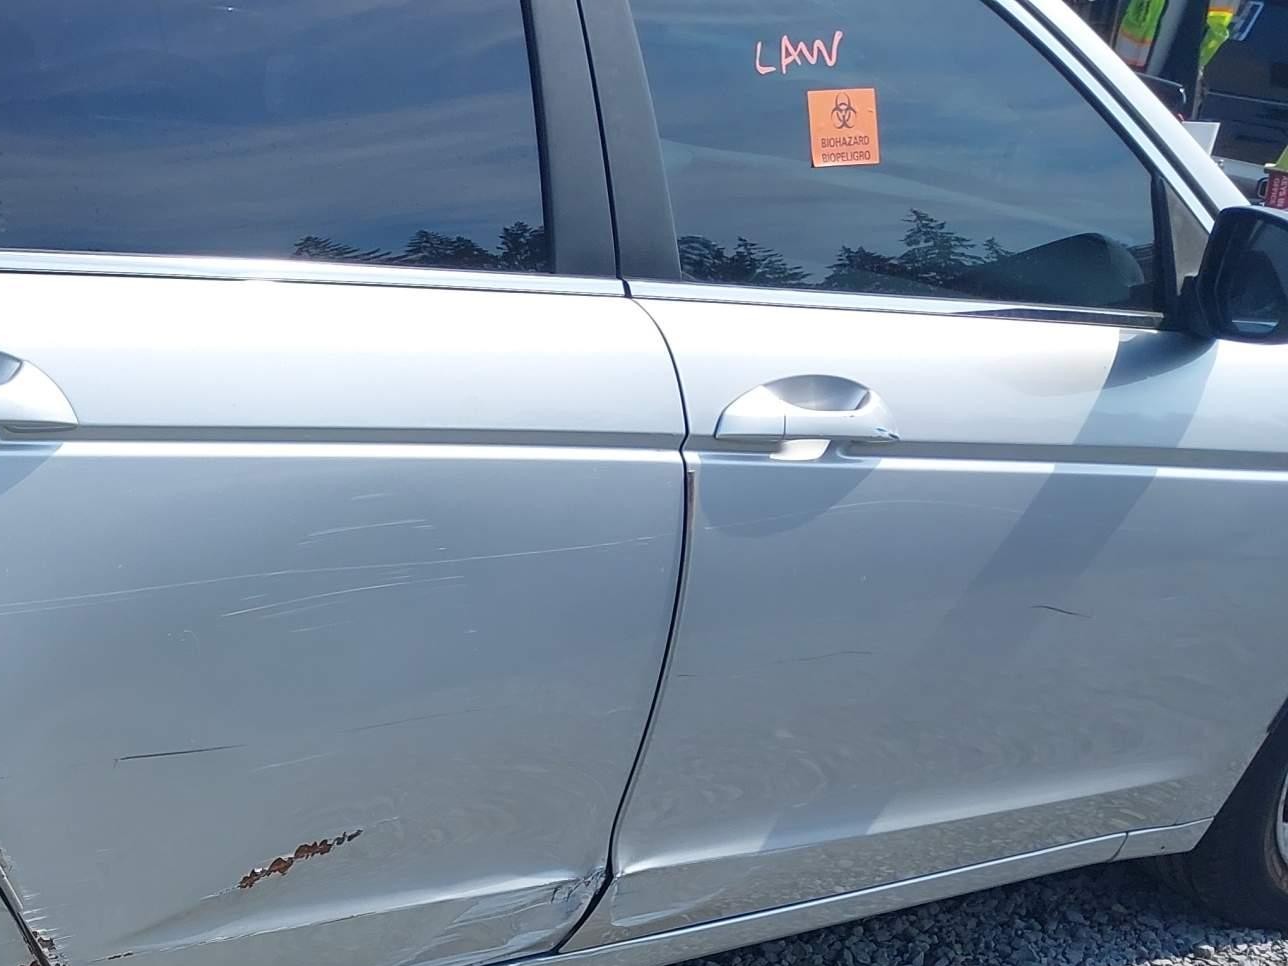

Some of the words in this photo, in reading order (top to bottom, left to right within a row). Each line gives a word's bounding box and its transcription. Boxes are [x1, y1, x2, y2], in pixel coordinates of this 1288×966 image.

[754, 30, 844, 75] LAW
[821, 135, 870, 148] BIOHAZARD
[822, 150, 871, 163] BIOPELIGRO
